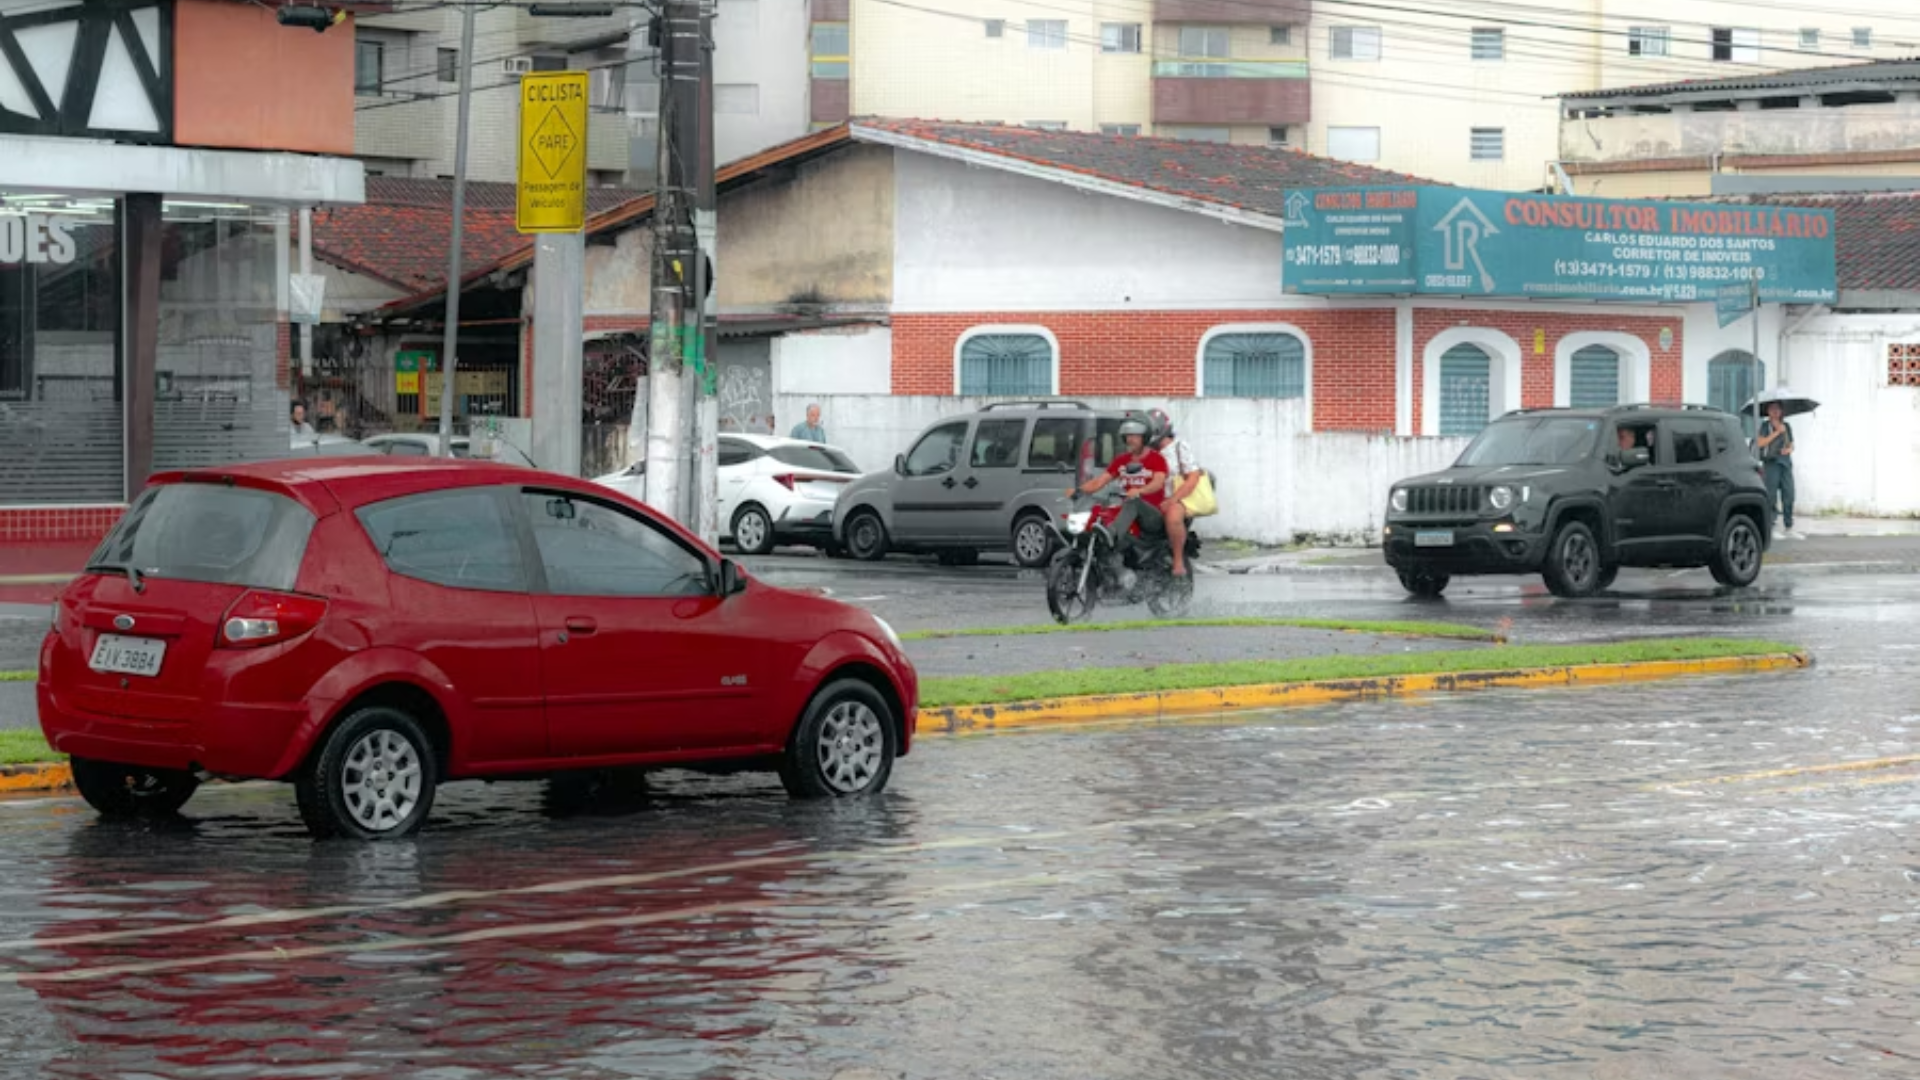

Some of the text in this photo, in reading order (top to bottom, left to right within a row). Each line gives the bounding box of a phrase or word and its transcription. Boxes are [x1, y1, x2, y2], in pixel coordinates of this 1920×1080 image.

[528, 83, 583, 102] CICLISTA
[538, 134, 569, 149] PARE
[524, 181, 581, 194] Passagem de
[1505, 199, 1828, 238] CONSULTOR IMOBILIÁRIO
[1585, 232, 1775, 251] CARLOS EDUARDO DOS SANTOS
[1613, 247, 1681, 260] CORRETOR
[1684, 250, 1700, 261] DE
[1664, 264, 1688, 280] (13)
